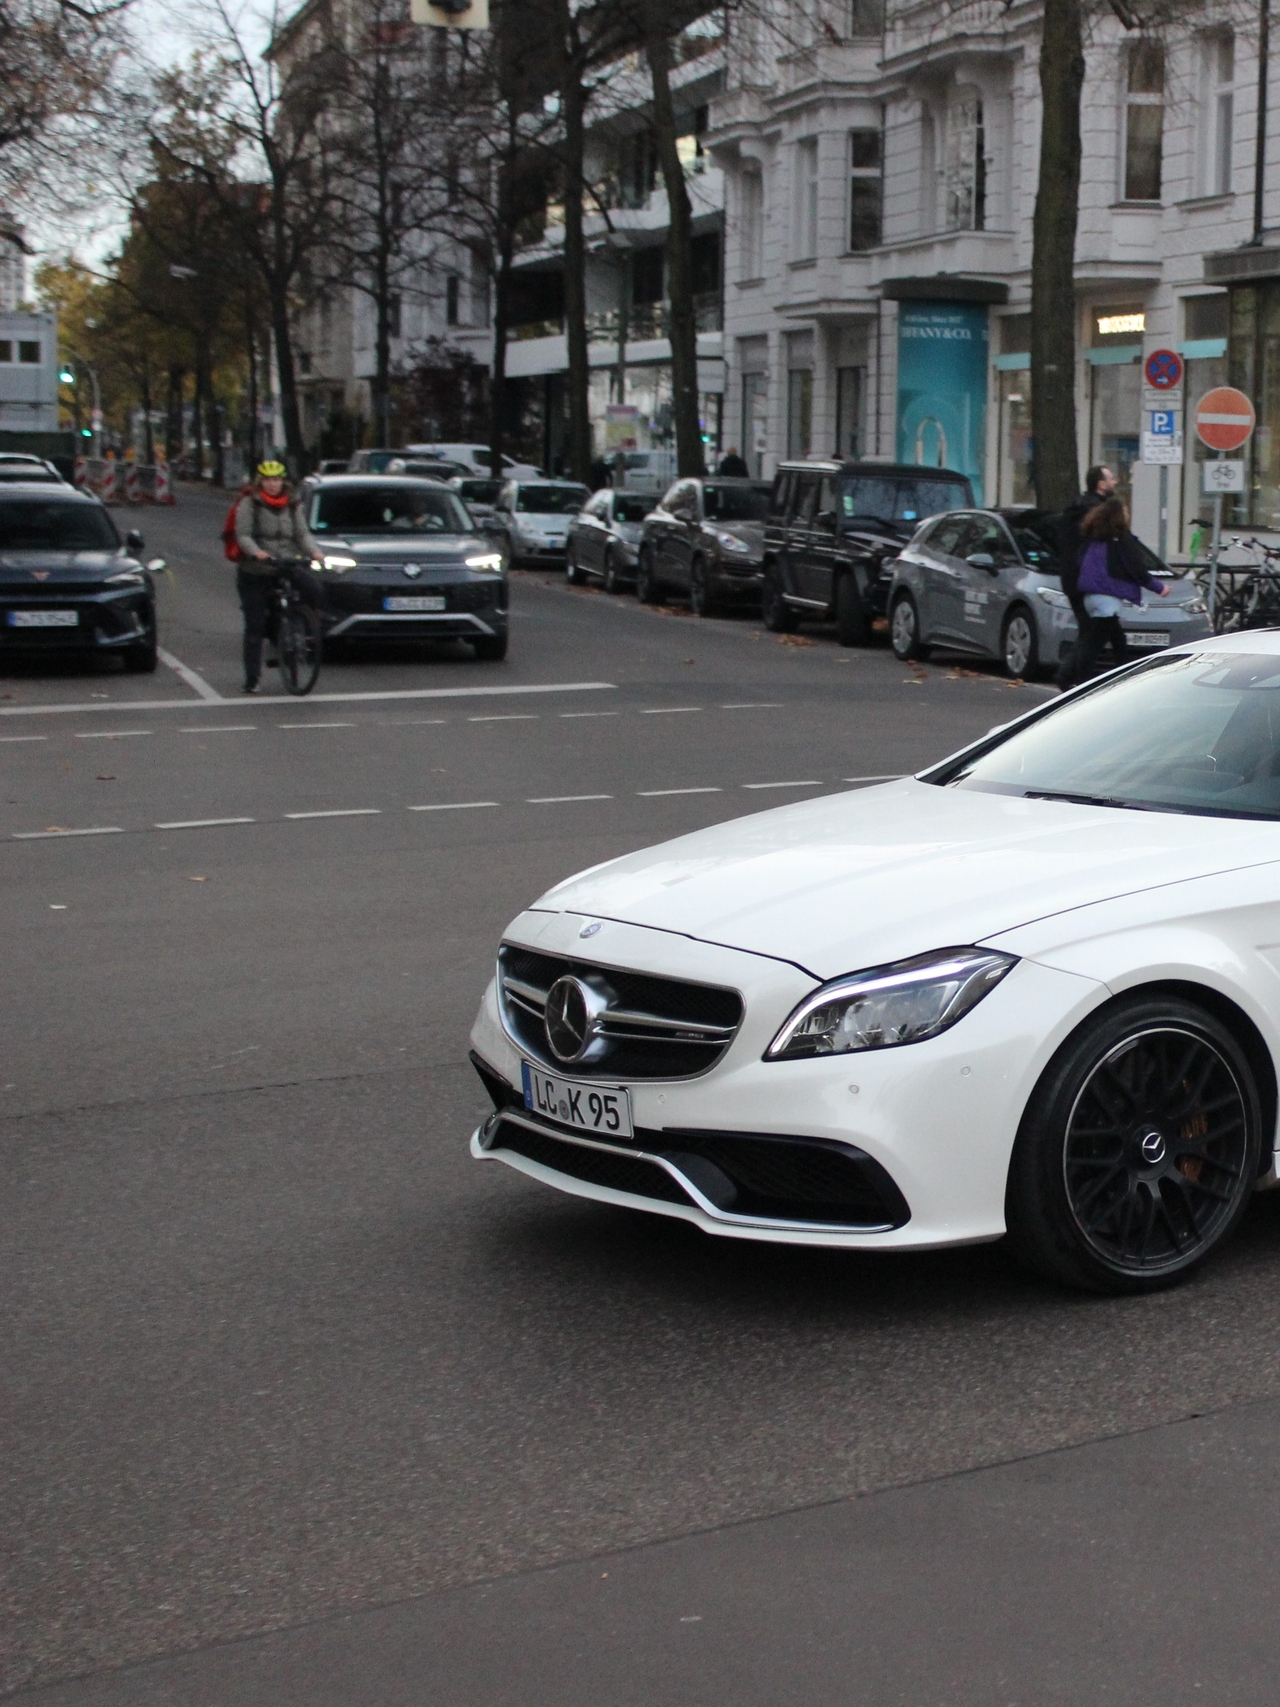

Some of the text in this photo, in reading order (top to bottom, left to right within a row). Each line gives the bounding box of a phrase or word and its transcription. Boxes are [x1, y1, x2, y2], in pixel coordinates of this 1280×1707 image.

[1153, 412, 1169, 432] P
[535, 1074, 620, 1131] LC K 95
